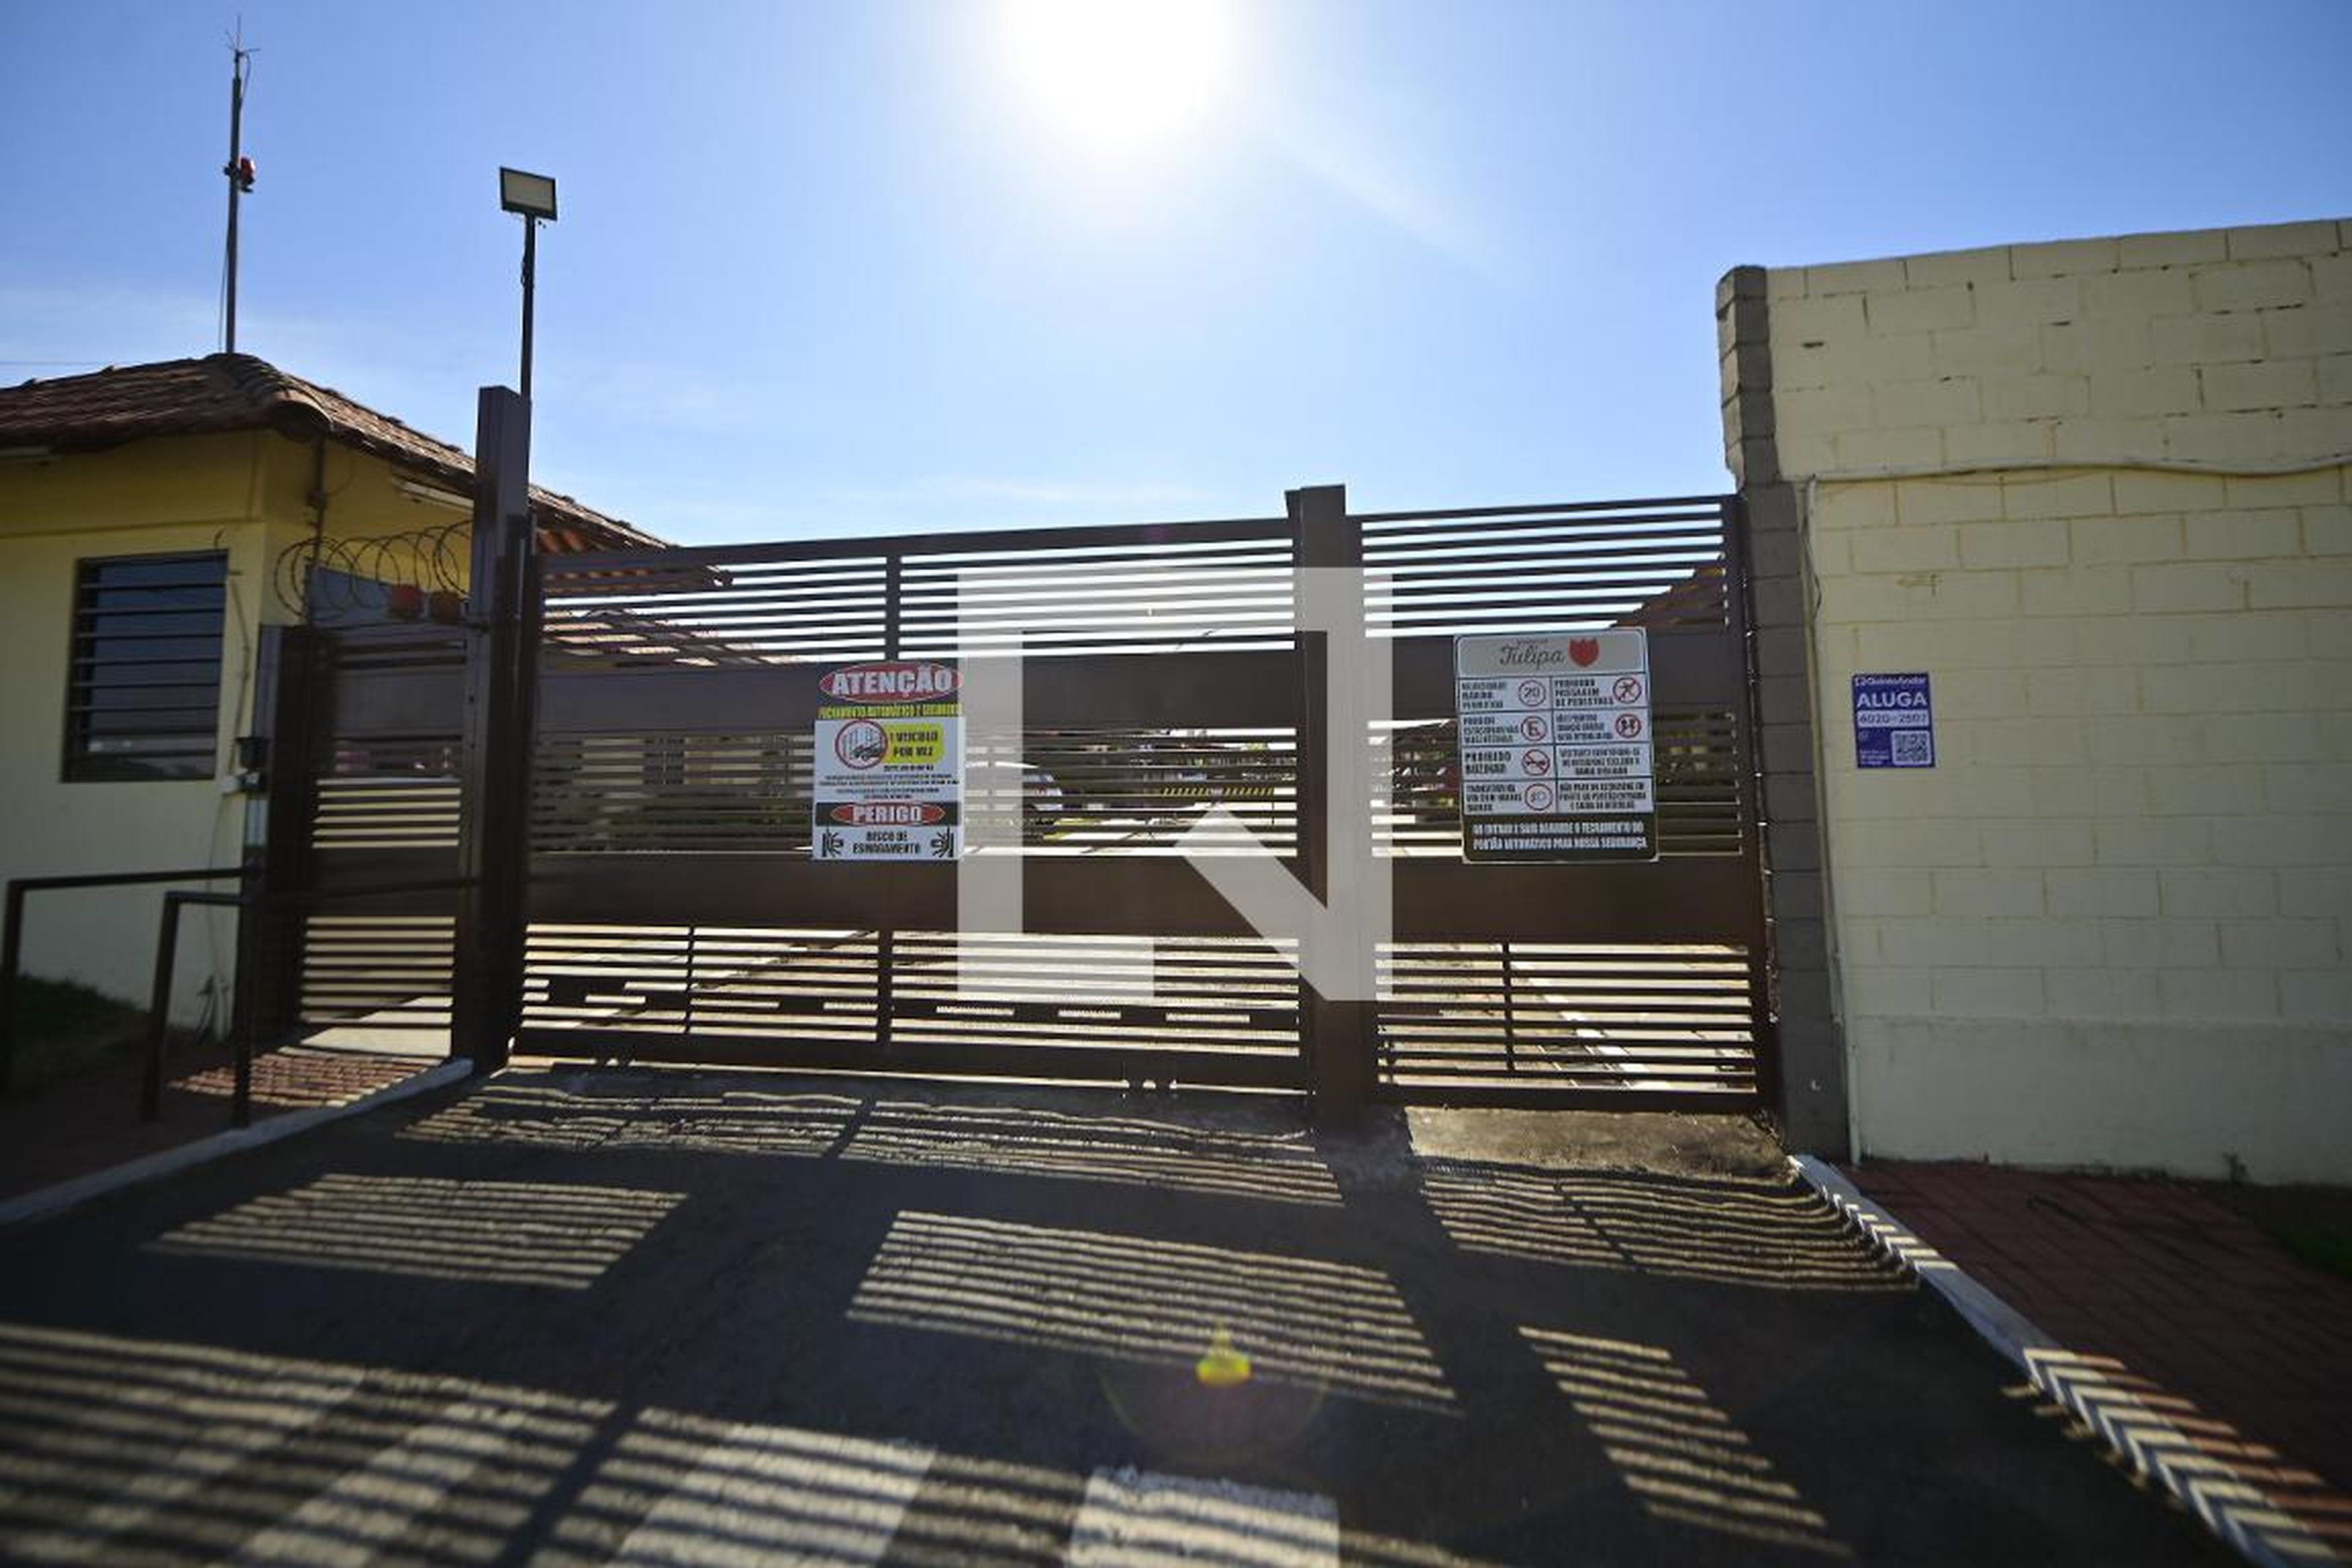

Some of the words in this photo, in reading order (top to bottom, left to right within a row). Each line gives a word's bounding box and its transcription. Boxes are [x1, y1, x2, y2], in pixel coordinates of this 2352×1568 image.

[1500, 646, 1564, 670] Tulipa
[832, 662, 952, 697] ATENÇÃO
[1857, 692, 1927, 707] ALUGA
[853, 805, 922, 822] PERIGO
